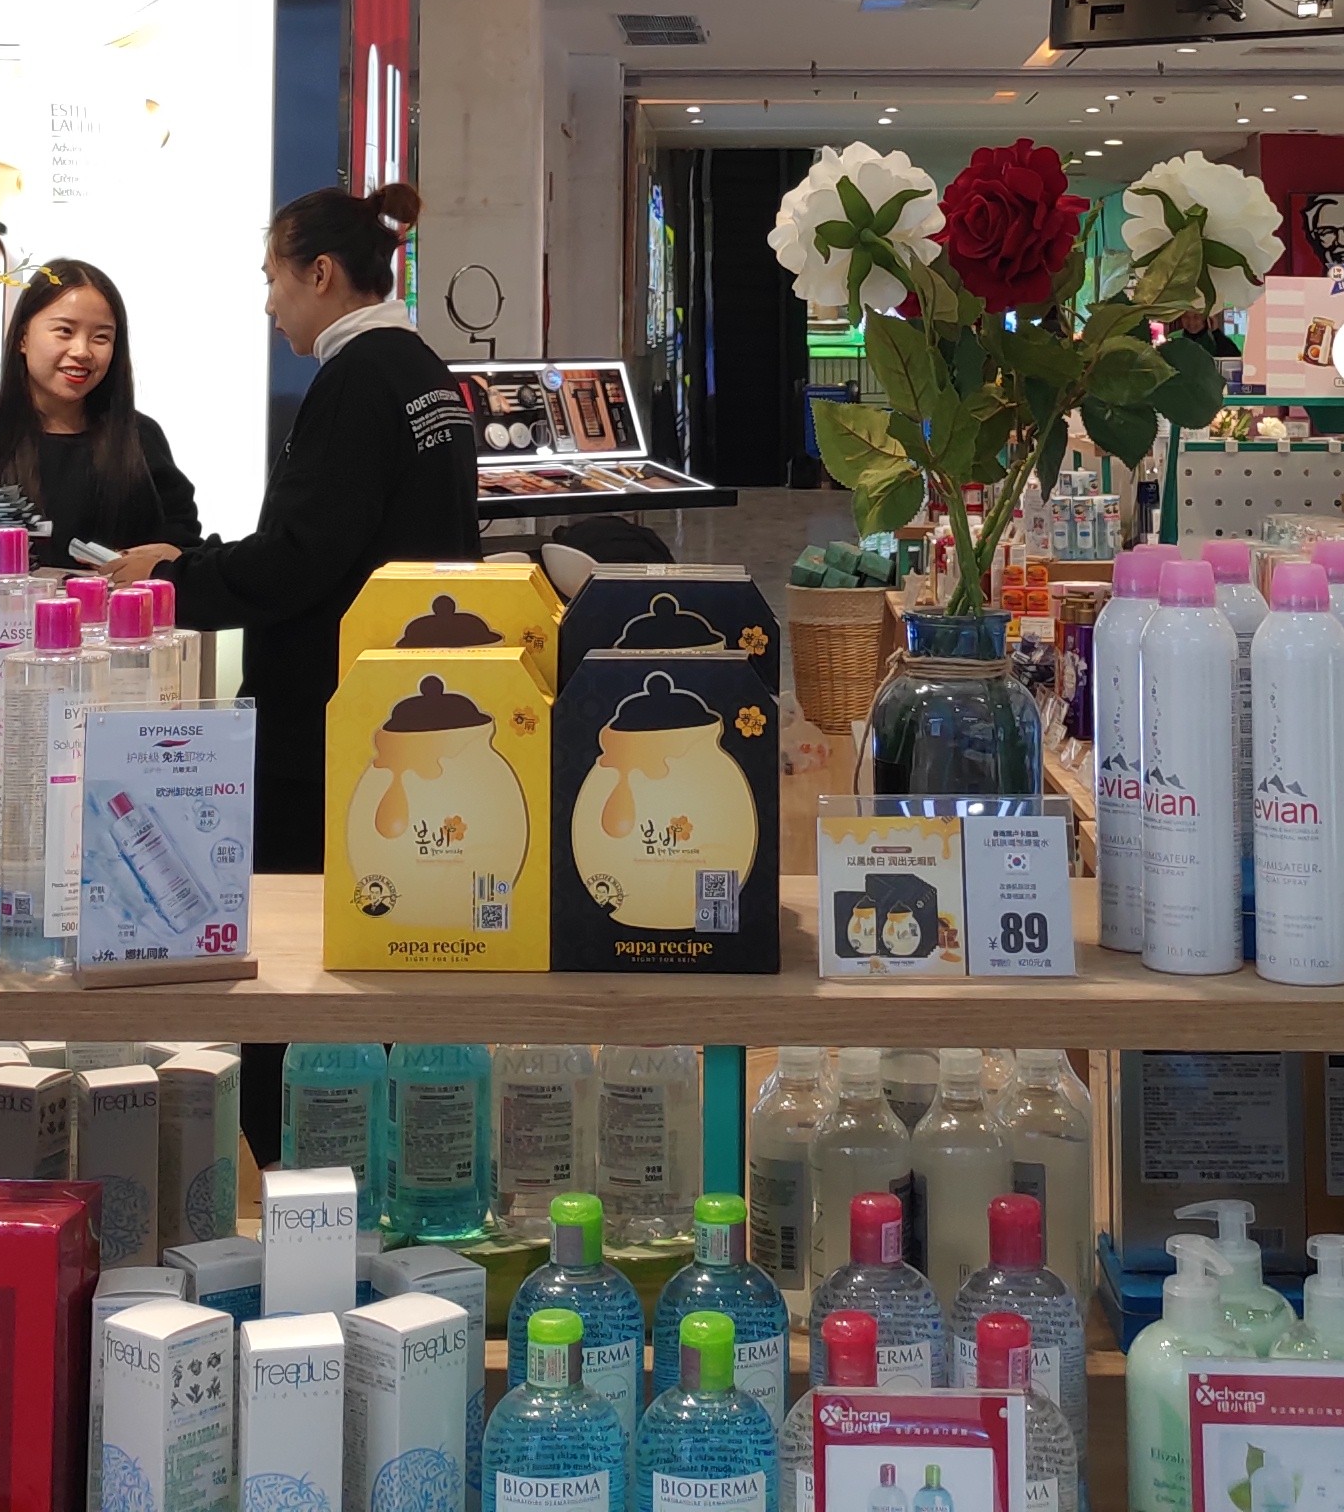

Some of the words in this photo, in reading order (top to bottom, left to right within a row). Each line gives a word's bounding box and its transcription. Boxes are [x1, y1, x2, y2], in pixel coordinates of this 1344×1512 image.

[139, 726, 203, 737] BYPHASSE
[1098, 774, 1140, 800] evia
[1144, 789, 1196, 816] vian
[988, 912, 1048, 954] ¥89
[388, 941, 430, 957] papa
[433, 938, 486, 955] recipe
[615, 940, 656, 957] papa
[659, 938, 713, 955] recipe
[269, 1202, 354, 1234] freeplus
[105, 1331, 161, 1375] freeplus
[401, 1325, 467, 1371] freeplus
[252, 1355, 342, 1391] freeplus
[502, 1477, 603, 1500] BIODERMA
[660, 1477, 759, 1500] BIODERMA
